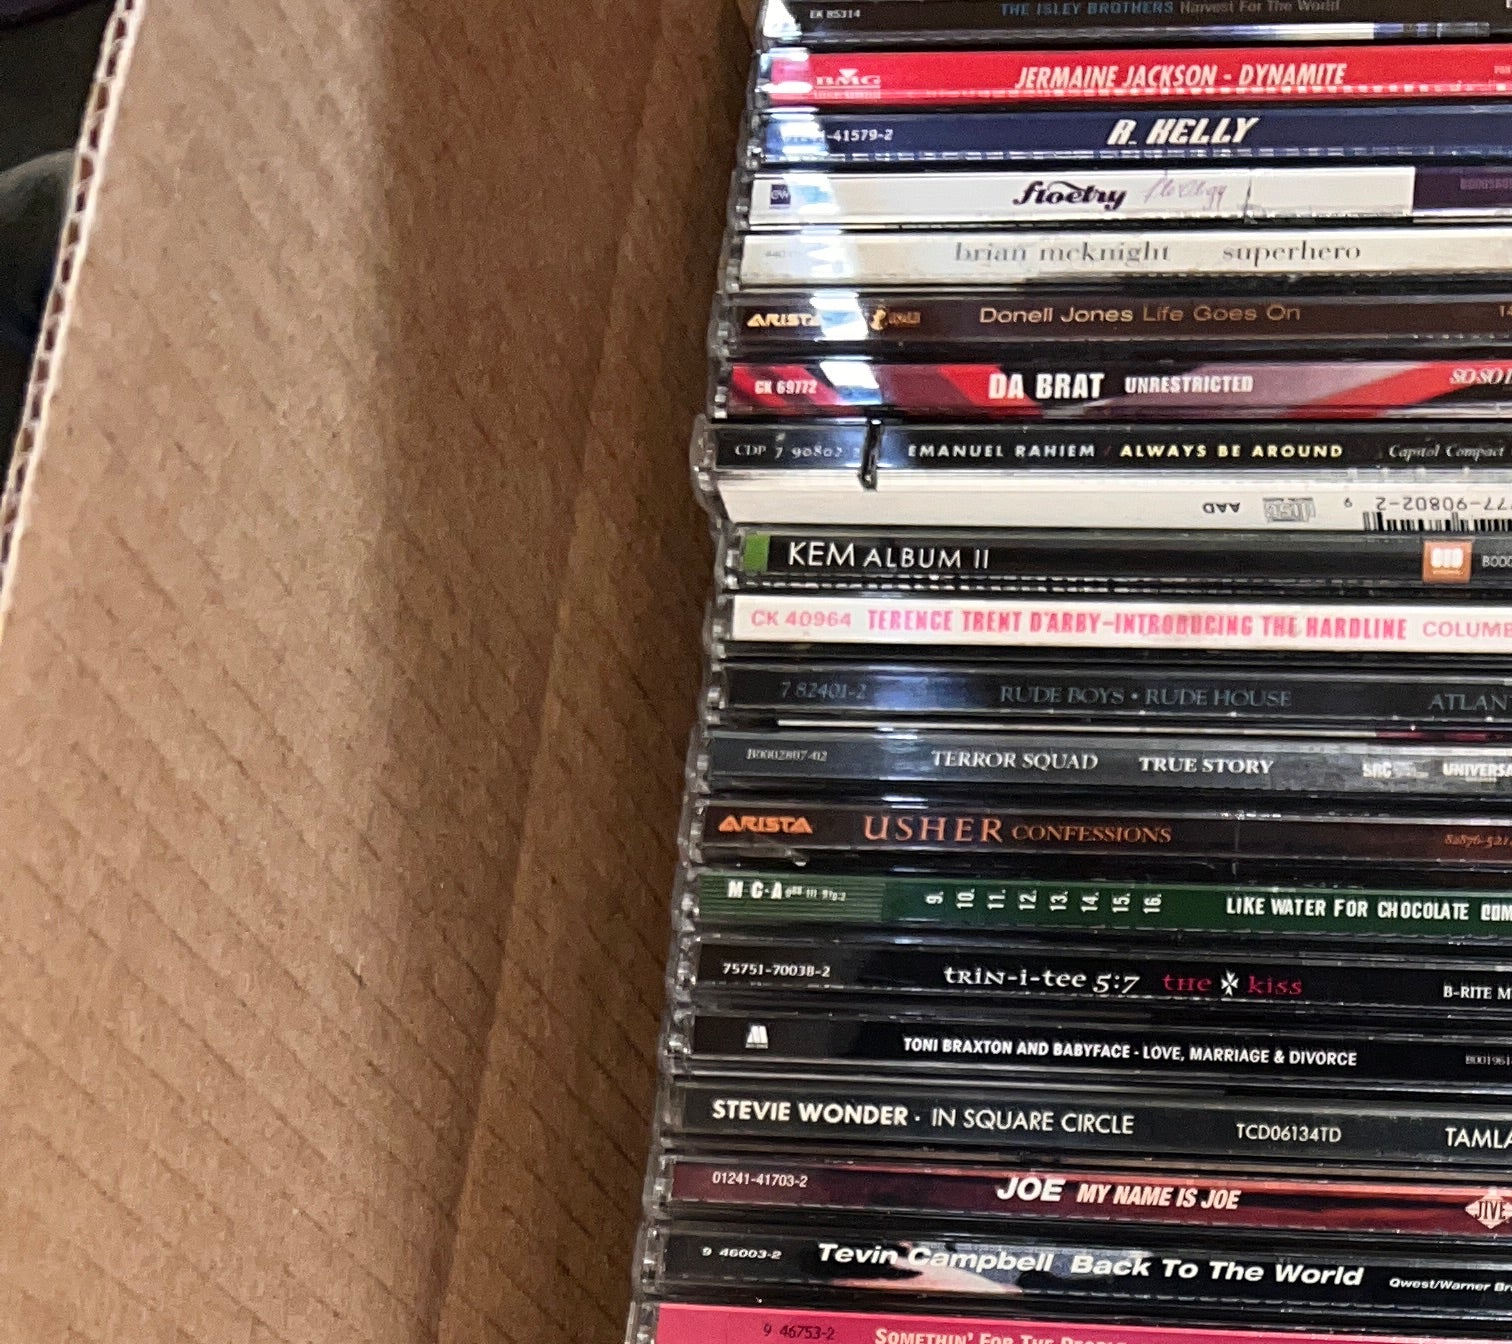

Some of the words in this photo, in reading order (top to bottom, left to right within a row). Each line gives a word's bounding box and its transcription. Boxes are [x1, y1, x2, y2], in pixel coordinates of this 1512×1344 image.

[1014, 66, 1116, 89] JERMAINE
[1122, 63, 1216, 87] JACKSON
[1238, 62, 1347, 87] DYNAMITE
[1106, 118, 1138, 145] R.
[1144, 117, 1261, 145] KELLY
[980, 307, 1054, 324] Donell
[1060, 305, 1133, 323] Jones
[1143, 305, 1184, 323] Life
[1193, 305, 1257, 323] Goes
[1266, 304, 1301, 321] On
[988, 373, 1024, 399] DA
[1035, 373, 1104, 399] BRAT
[1124, 374, 1254, 395] UNRESTRICTED
[1119, 444, 1207, 459] ALWAYS
[1217, 445, 1242, 458] BE
[1252, 445, 1343, 458] AROUND
[787, 542, 855, 567] KEM
[864, 548, 961, 569] ALBUM
[974, 550, 989, 569] II
[750, 611, 781, 627] CK
[785, 611, 852, 628] 40964
[931, 749, 1017, 768] TERROR
[1022, 753, 1099, 771] SQUAD
[1139, 757, 1197, 773] TRUE
[1202, 759, 1275, 775] STORY
[718, 815, 814, 835] ARISTA
[864, 815, 1004, 843] USHER
[1011, 826, 1171, 843] CONFESSIONS
[1226, 897, 1265, 915] LIKE
[1271, 898, 1325, 917] WATER
[1334, 900, 1368, 918] FOR
[1377, 901, 1469, 921] CHOCOLATE
[722, 962, 831, 978] 75751-70038-2
[1443, 985, 1492, 1000] B-RITE
[712, 1100, 790, 1122] STEVIE
[799, 1103, 908, 1126] WONDER
[1235, 1123, 1342, 1143] TCD06134TD
[712, 1171, 808, 1187] 01241-41703-2
[996, 1177, 1067, 1201] JOE
[1075, 1183, 1109, 1204] MY
[1113, 1186, 1172, 1207] NAME
[1177, 1188, 1197, 1207] IS
[1201, 1189, 1242, 1211] JOE
[818, 1243, 899, 1266] Tevin
[908, 1247, 1054, 1273] Campbell
[1070, 1254, 1151, 1277] Back
[1162, 1259, 1199, 1278] To
[1209, 1261, 1265, 1283] The
[1274, 1264, 1365, 1287] World
